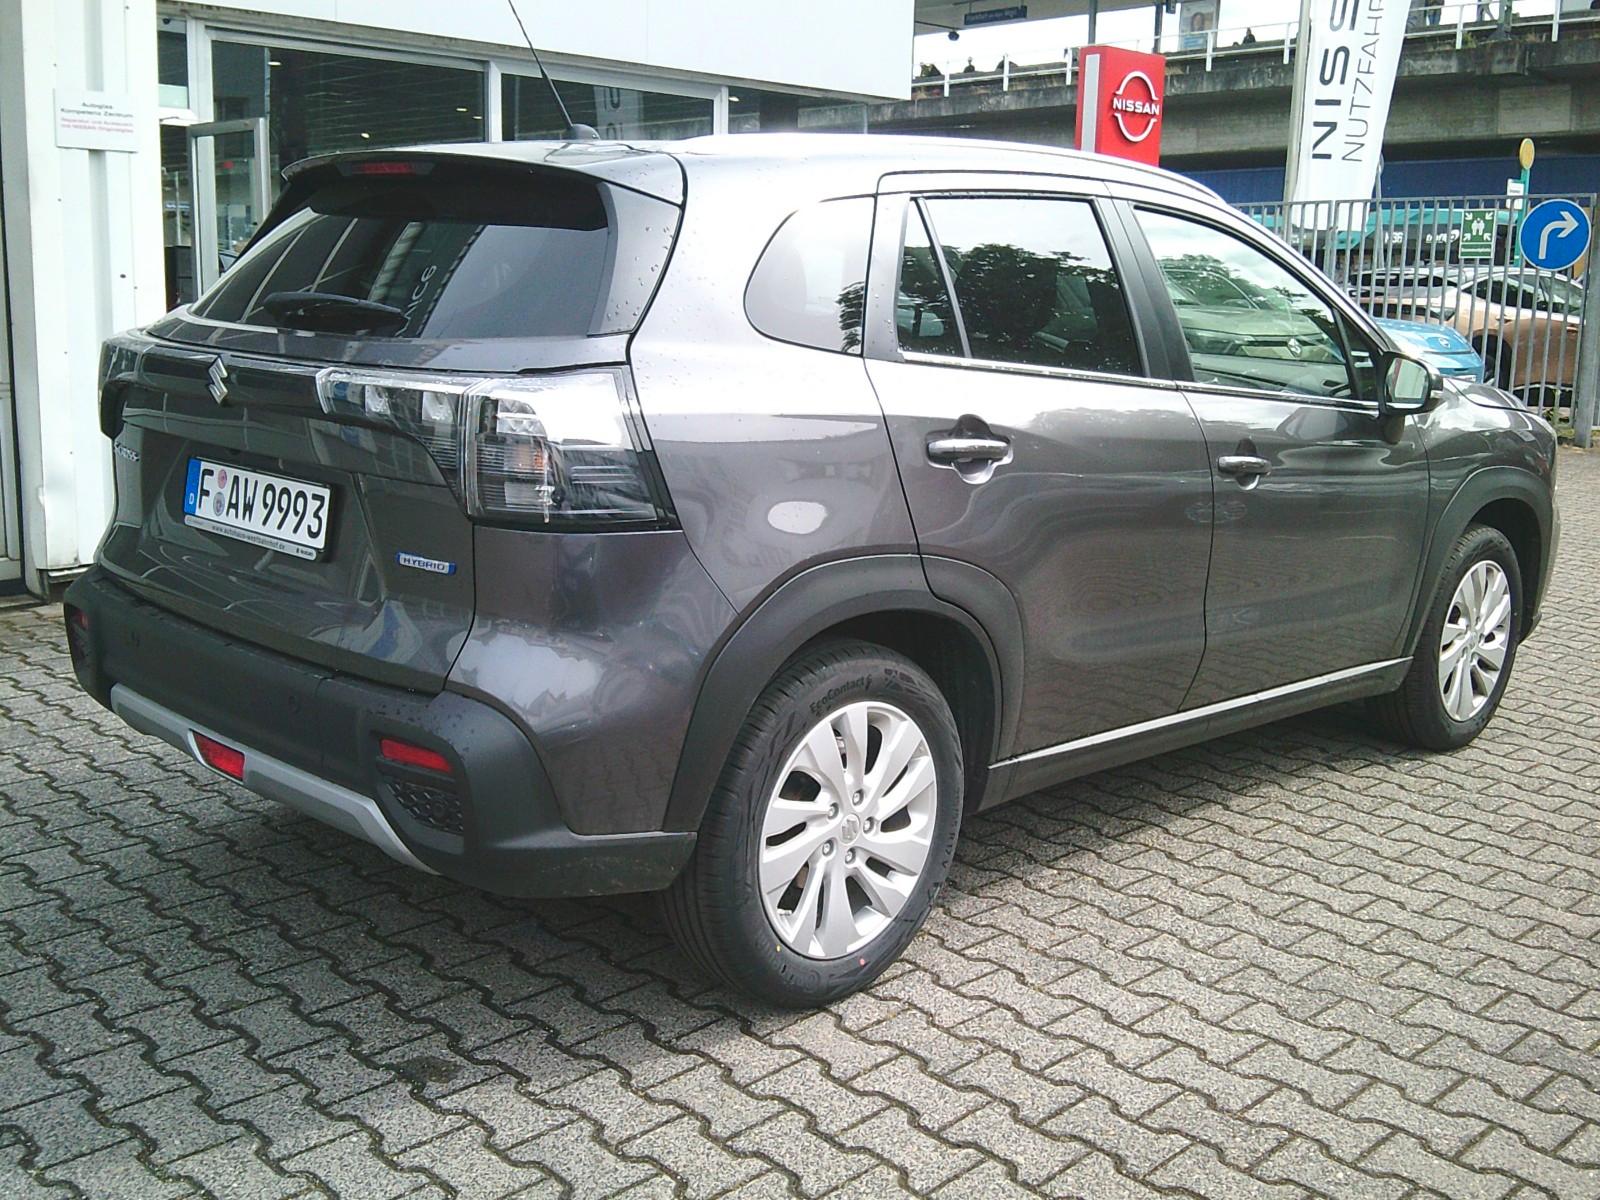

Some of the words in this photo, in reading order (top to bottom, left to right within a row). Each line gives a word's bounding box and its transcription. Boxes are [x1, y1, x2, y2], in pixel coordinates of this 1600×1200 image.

[1113, 97, 1160, 116] NISSAN
[188, 493, 195, 505] D
[199, 468, 214, 509] F
[226, 475, 258, 523] AW
[262, 483, 326, 540] 9993
[403, 557, 445, 571] HYBRID
